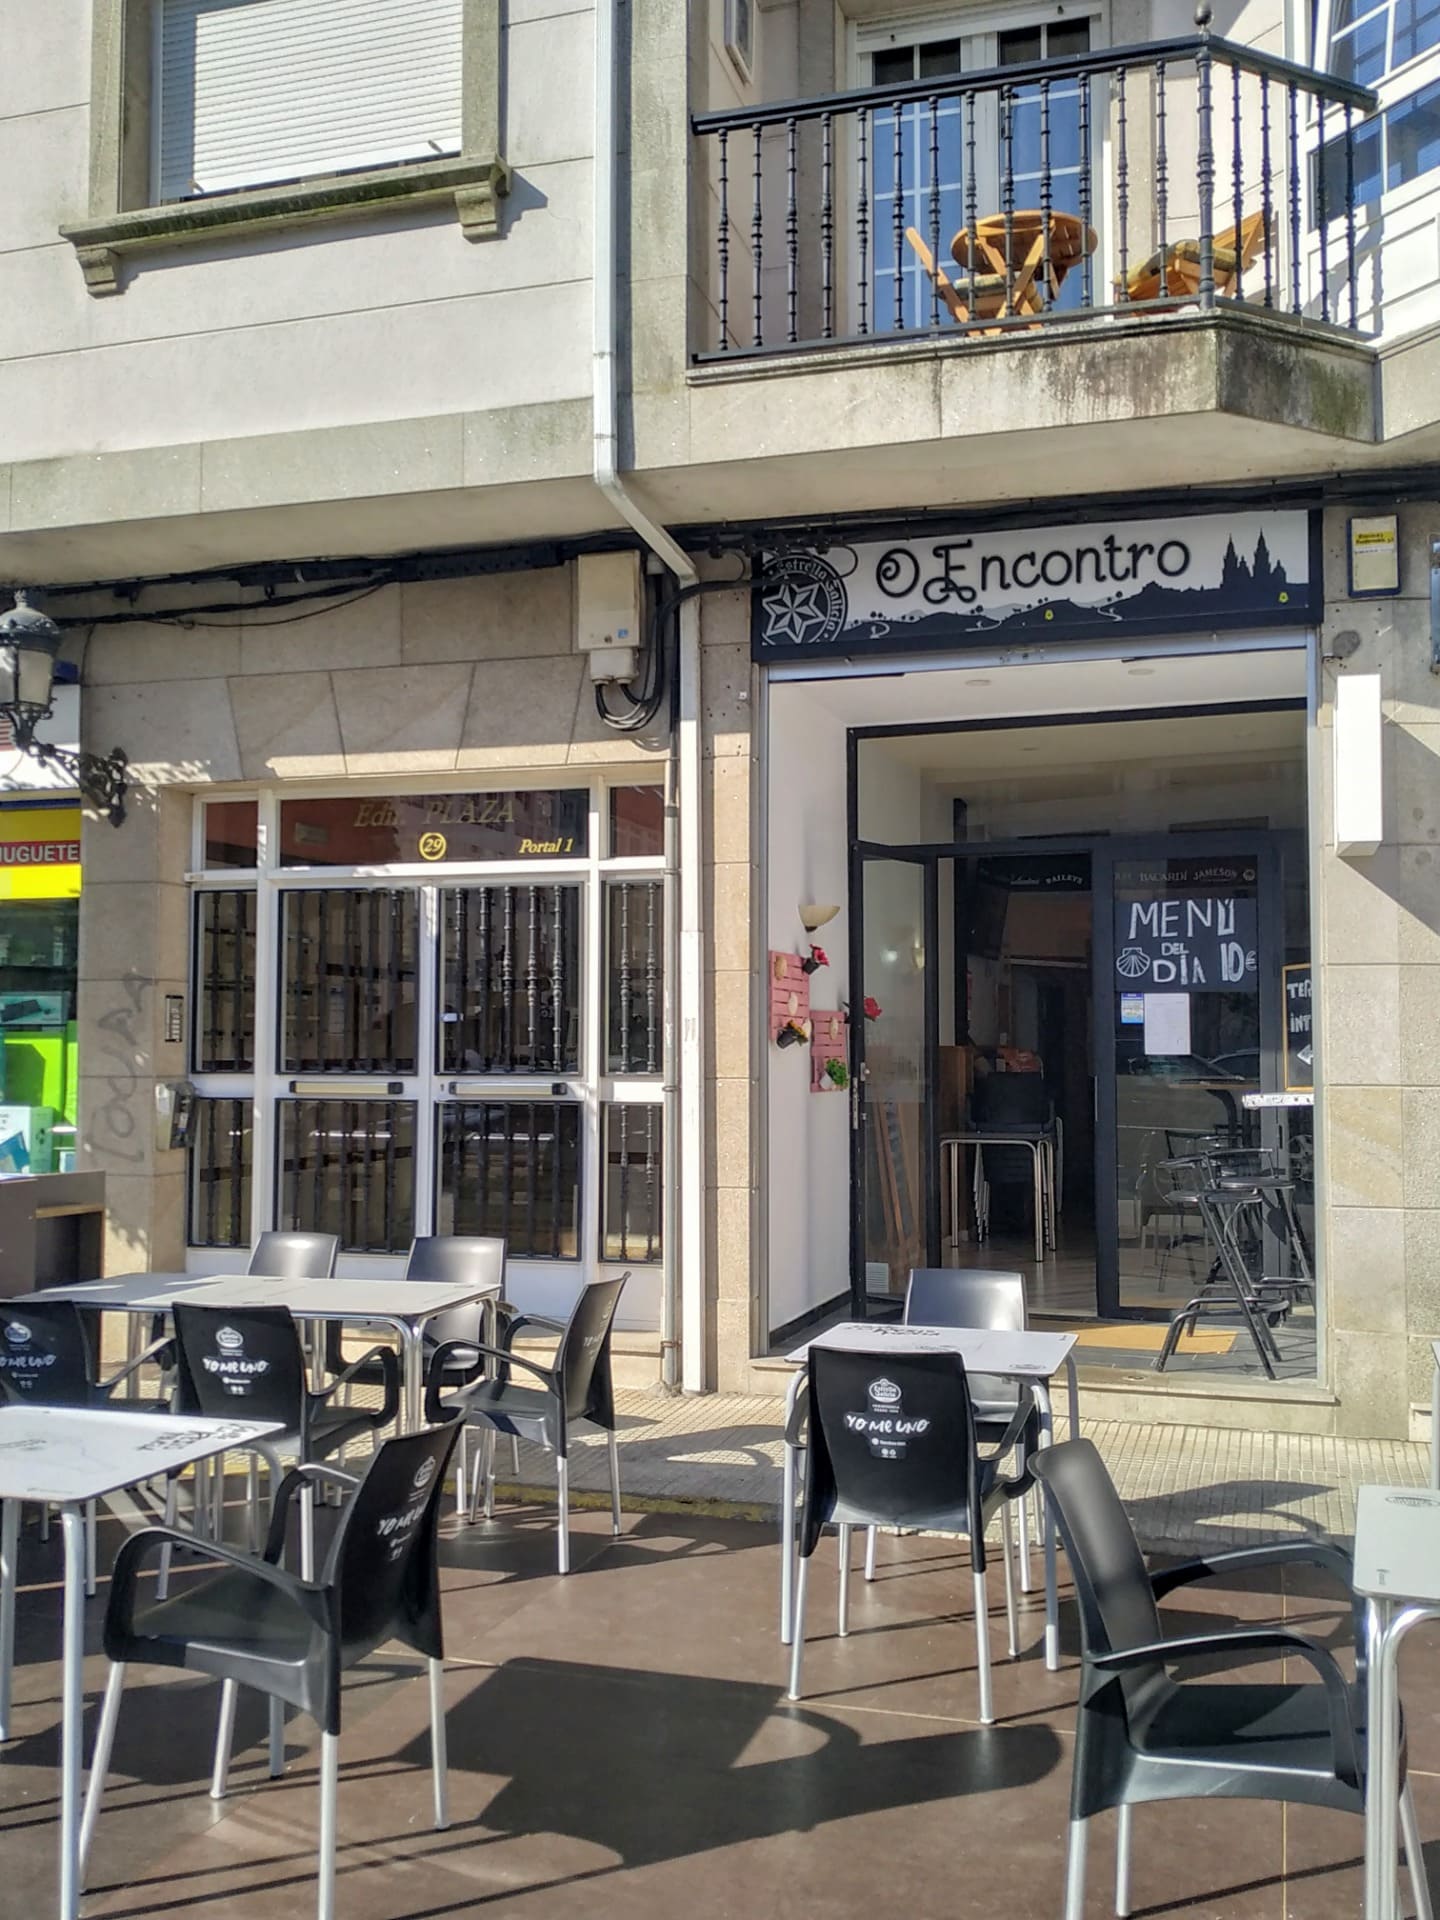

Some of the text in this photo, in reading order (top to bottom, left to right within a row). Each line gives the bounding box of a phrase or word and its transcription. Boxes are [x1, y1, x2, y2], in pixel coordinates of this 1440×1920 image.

[876, 534, 1190, 604] O Encontro
[422, 799, 514, 825] PLAZA
[423, 838, 442, 853] 29
[518, 837, 573, 854] Portal 1
[1192, 866, 1238, 881] JAMESON
[1161, 942, 1190, 956] DEL
[202, 1357, 220, 1373] YO
[846, 1414, 868, 1431] YO
[895, 1418, 931, 1434] UNO
